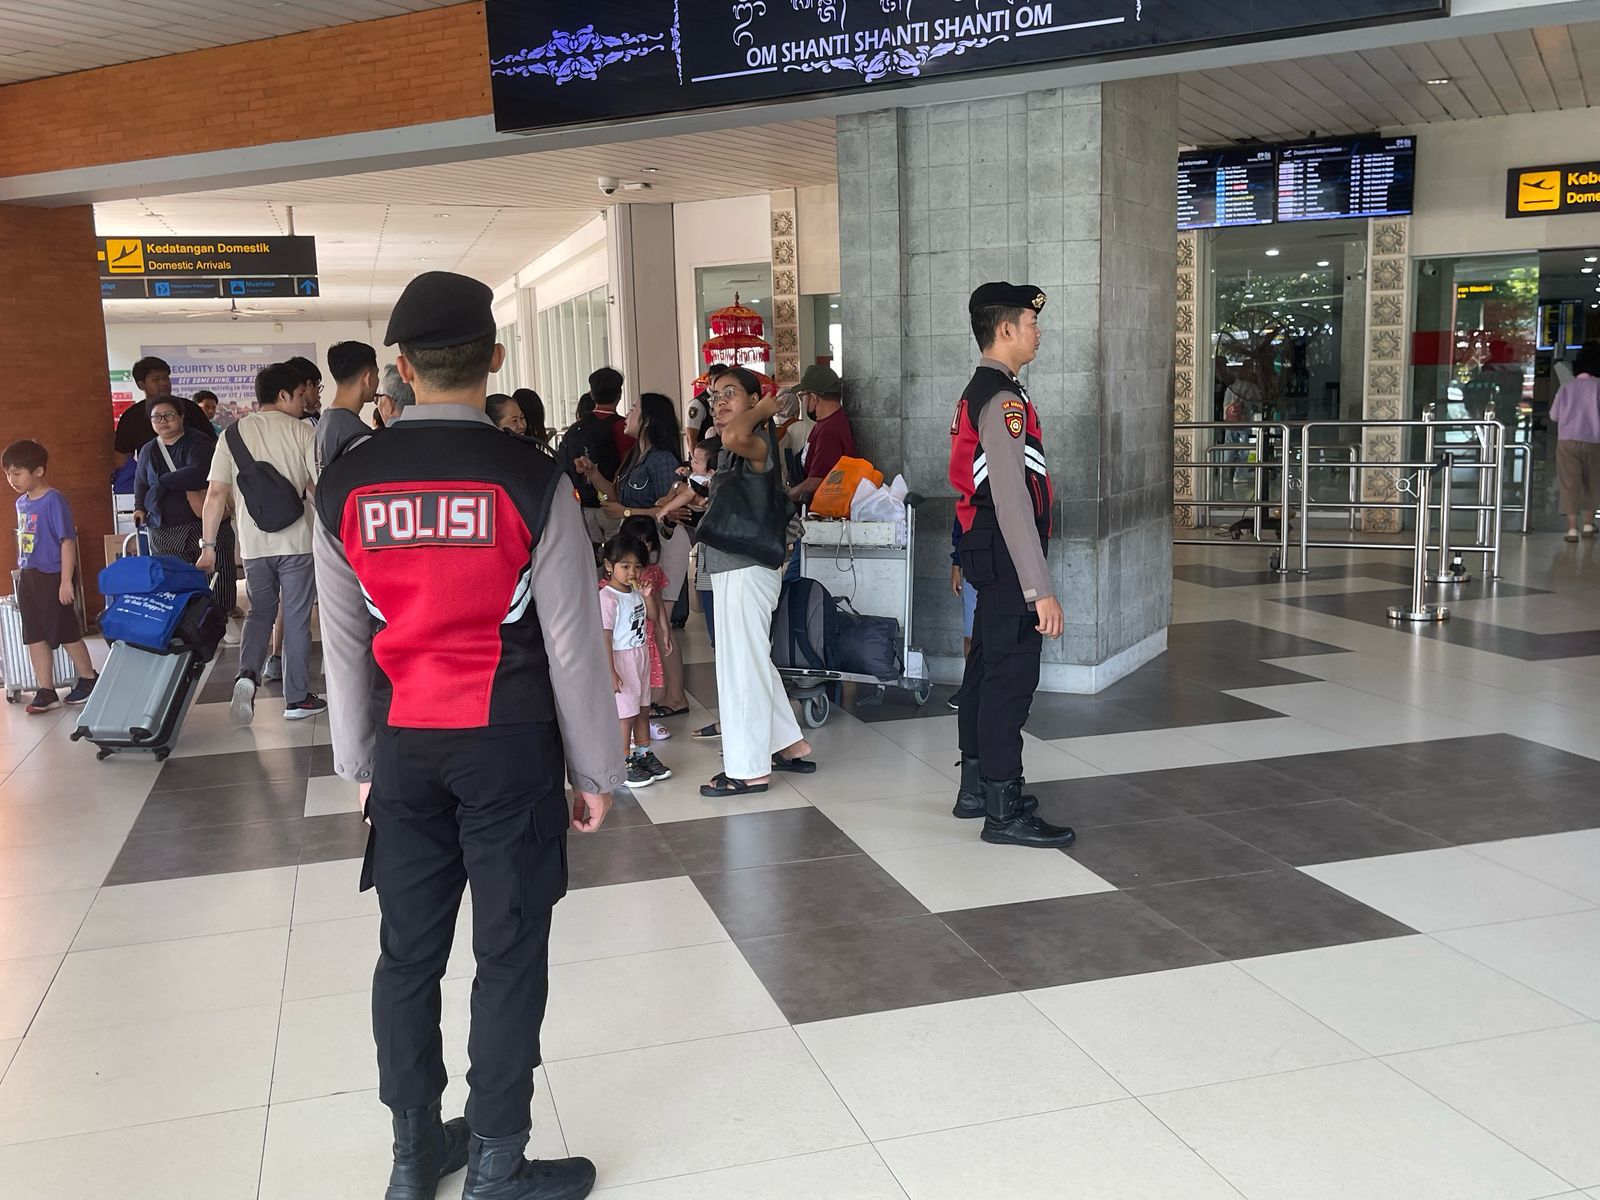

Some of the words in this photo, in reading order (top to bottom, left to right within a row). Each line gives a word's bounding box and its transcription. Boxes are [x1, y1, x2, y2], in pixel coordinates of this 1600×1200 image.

[746, 45, 777, 67] OM
[781, 34, 850, 63] SHANTI
[854, 22, 929, 53] SHANTI
[933, 9, 1010, 40] SHANTI
[1015, 3, 1052, 28] OM
[1567, 171, 1600, 186] Keb
[146, 243, 214, 255] Kedatangan
[217, 243, 270, 253] Domestik
[148, 260, 194, 270] Domestic
[196, 260, 232, 270] Arrivals
[171, 364, 213, 374] ECURITY
[216, 365, 225, 373] IS
[227, 364, 247, 373] OUR
[363, 496, 488, 542] POLISI
